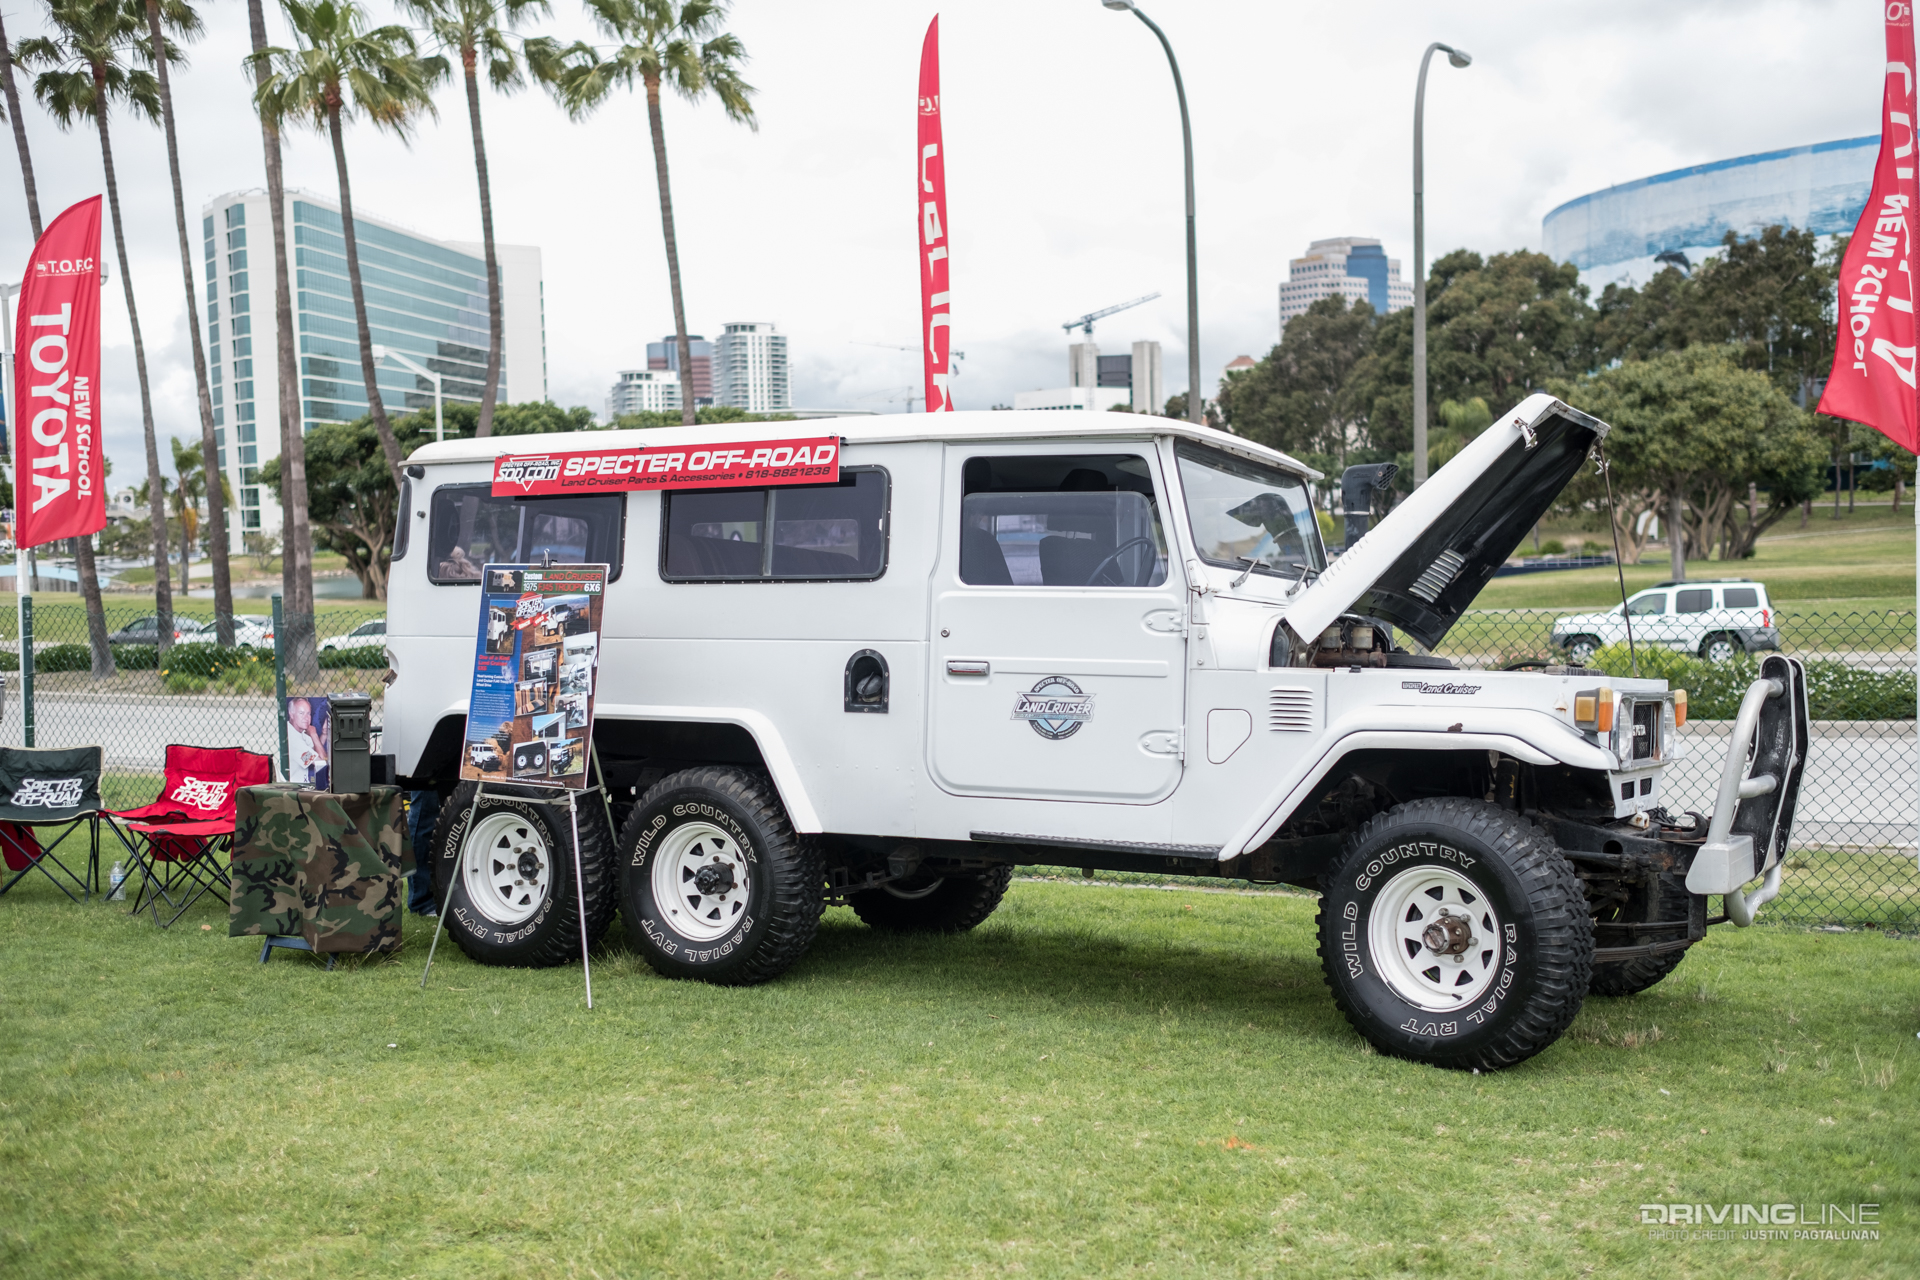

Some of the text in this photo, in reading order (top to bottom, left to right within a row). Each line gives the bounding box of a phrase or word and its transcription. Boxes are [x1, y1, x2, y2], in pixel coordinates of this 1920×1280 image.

[30, 303, 72, 514] TOYOTA
[74, 376, 92, 501] NEW SCHOOL
[563, 445, 837, 476] SPECTER OFF-ROAD
[561, 466, 831, 487] Land Cruiser Parts & Accessories 818-8821238
[523, 582, 538, 592] 1975
[538, 582, 554, 592] FJ45
[555, 583, 585, 592] TROOPY
[1033, 677, 1056, 693] SPECTER
[1420, 683, 1443, 693] Land
[1444, 683, 1480, 694] Cruiser
[18, 778, 82, 793] SPECTER
[180, 776, 229, 794] SPECTER
[444, 807, 473, 859] WILD
[632, 803, 757, 866] WILD COUNTRY
[454, 896, 553, 944] RADIAL RVT
[1342, 901, 1364, 979] WILD
[1355, 842, 1476, 892] COUNTRY
[641, 916, 754, 962] RADIAL RVT
[1400, 923, 1518, 1037] RADIAL RVT
